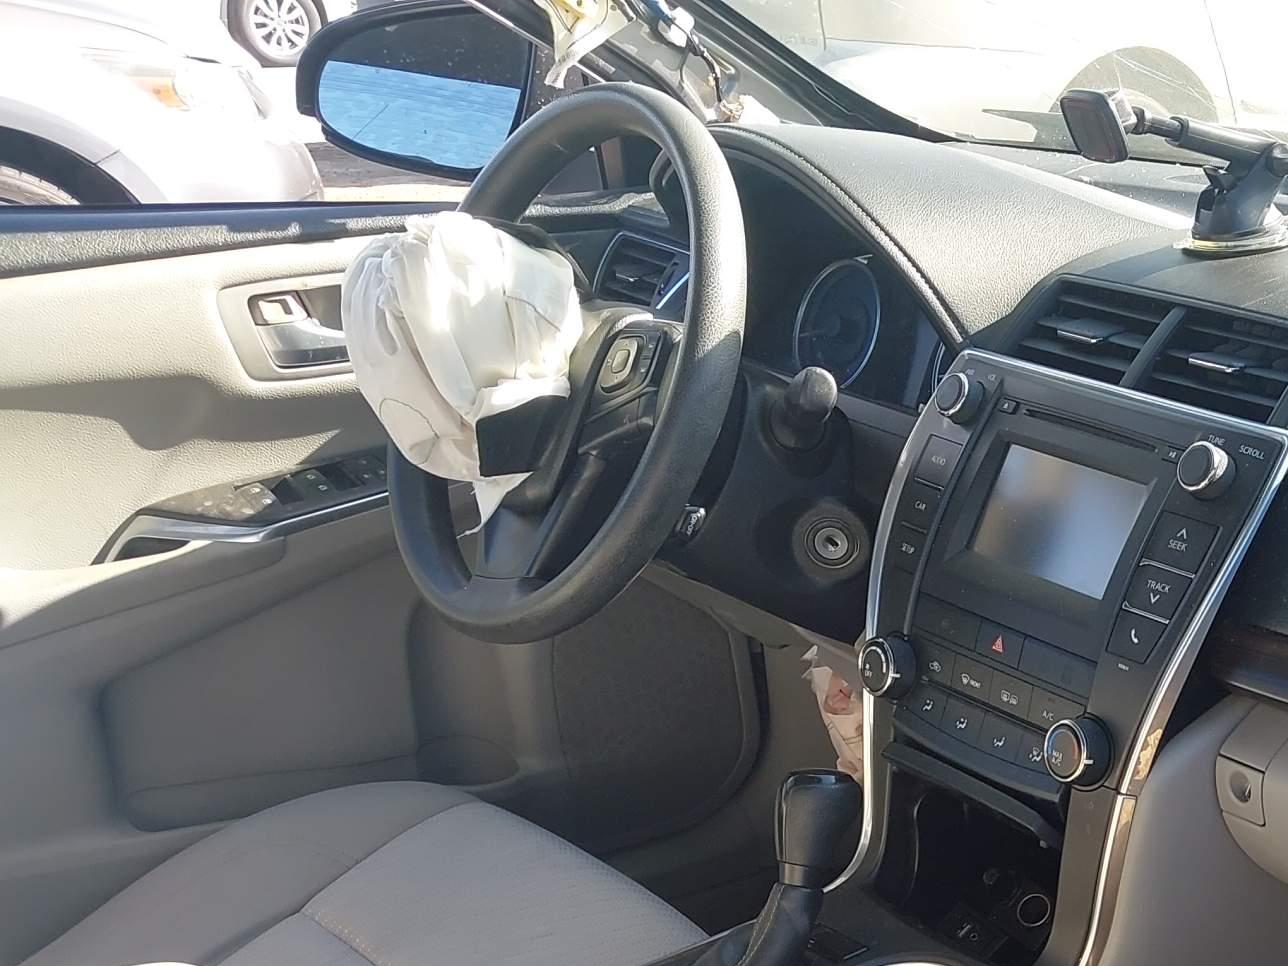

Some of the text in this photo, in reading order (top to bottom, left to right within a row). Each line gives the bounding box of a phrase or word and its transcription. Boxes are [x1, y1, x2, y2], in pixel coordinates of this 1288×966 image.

[1208, 434, 1225, 446] TUNE
[1239, 444, 1265, 459] SCROLL
[914, 500, 926, 511] CAR
[1168, 539, 1187, 552] SEEK
[1147, 579, 1171, 593] TRACK
[1042, 709, 1055, 721] A/C
